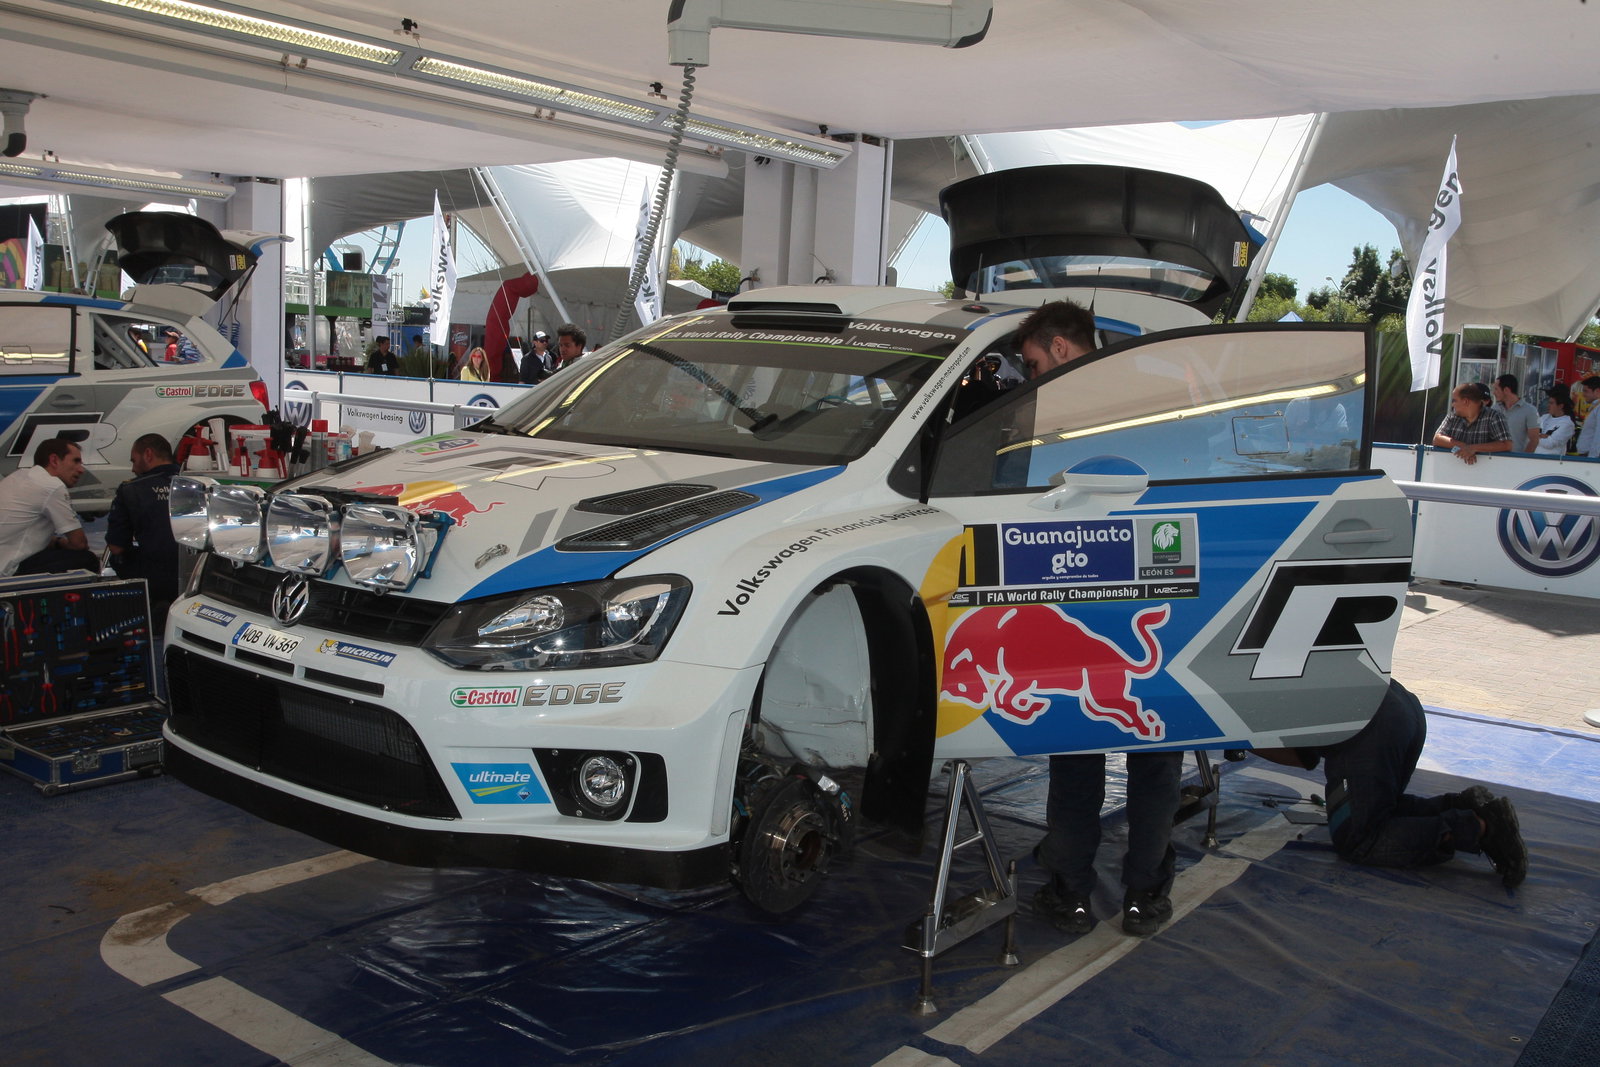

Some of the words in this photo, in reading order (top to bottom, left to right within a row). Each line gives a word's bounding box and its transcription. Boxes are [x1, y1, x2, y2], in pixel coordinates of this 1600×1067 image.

[682, 331, 718, 339] World
[716, 331, 750, 341] Rally
[748, 332, 844, 346] Championship
[848, 321, 957, 340] Volkswagen
[165, 387, 192, 397] Castrol
[194, 385, 246, 397] EDGE
[910, 346, 972, 420] www.volkswagen-motorsport.com
[346, 407, 380, 420] Volkswagen
[380, 409, 404, 424] Leasing
[1004, 526, 1132, 549] Guanajuato
[717, 534, 824, 618] Volkswagen
[815, 515, 888, 541] Financial
[882, 507, 941, 522] Services
[1051, 550, 1089, 574] gto
[1141, 568, 1162, 577] LEÓN
[1164, 568, 1174, 576] ES
[987, 592, 1005, 603] FIA
[1006, 589, 1038, 602] World
[1039, 588, 1067, 603] Rally
[1068, 587, 1139, 600] Championship
[200, 608, 234, 623] MICHELIN
[1240, 570, 1410, 680] R
[240, 627, 263, 644] WOB
[275, 637, 299, 653] 369
[339, 645, 394, 664] MICHELIN
[468, 689, 517, 706] Castrol
[522, 681, 626, 707] EDGE
[469, 771, 531, 783] ultimate
